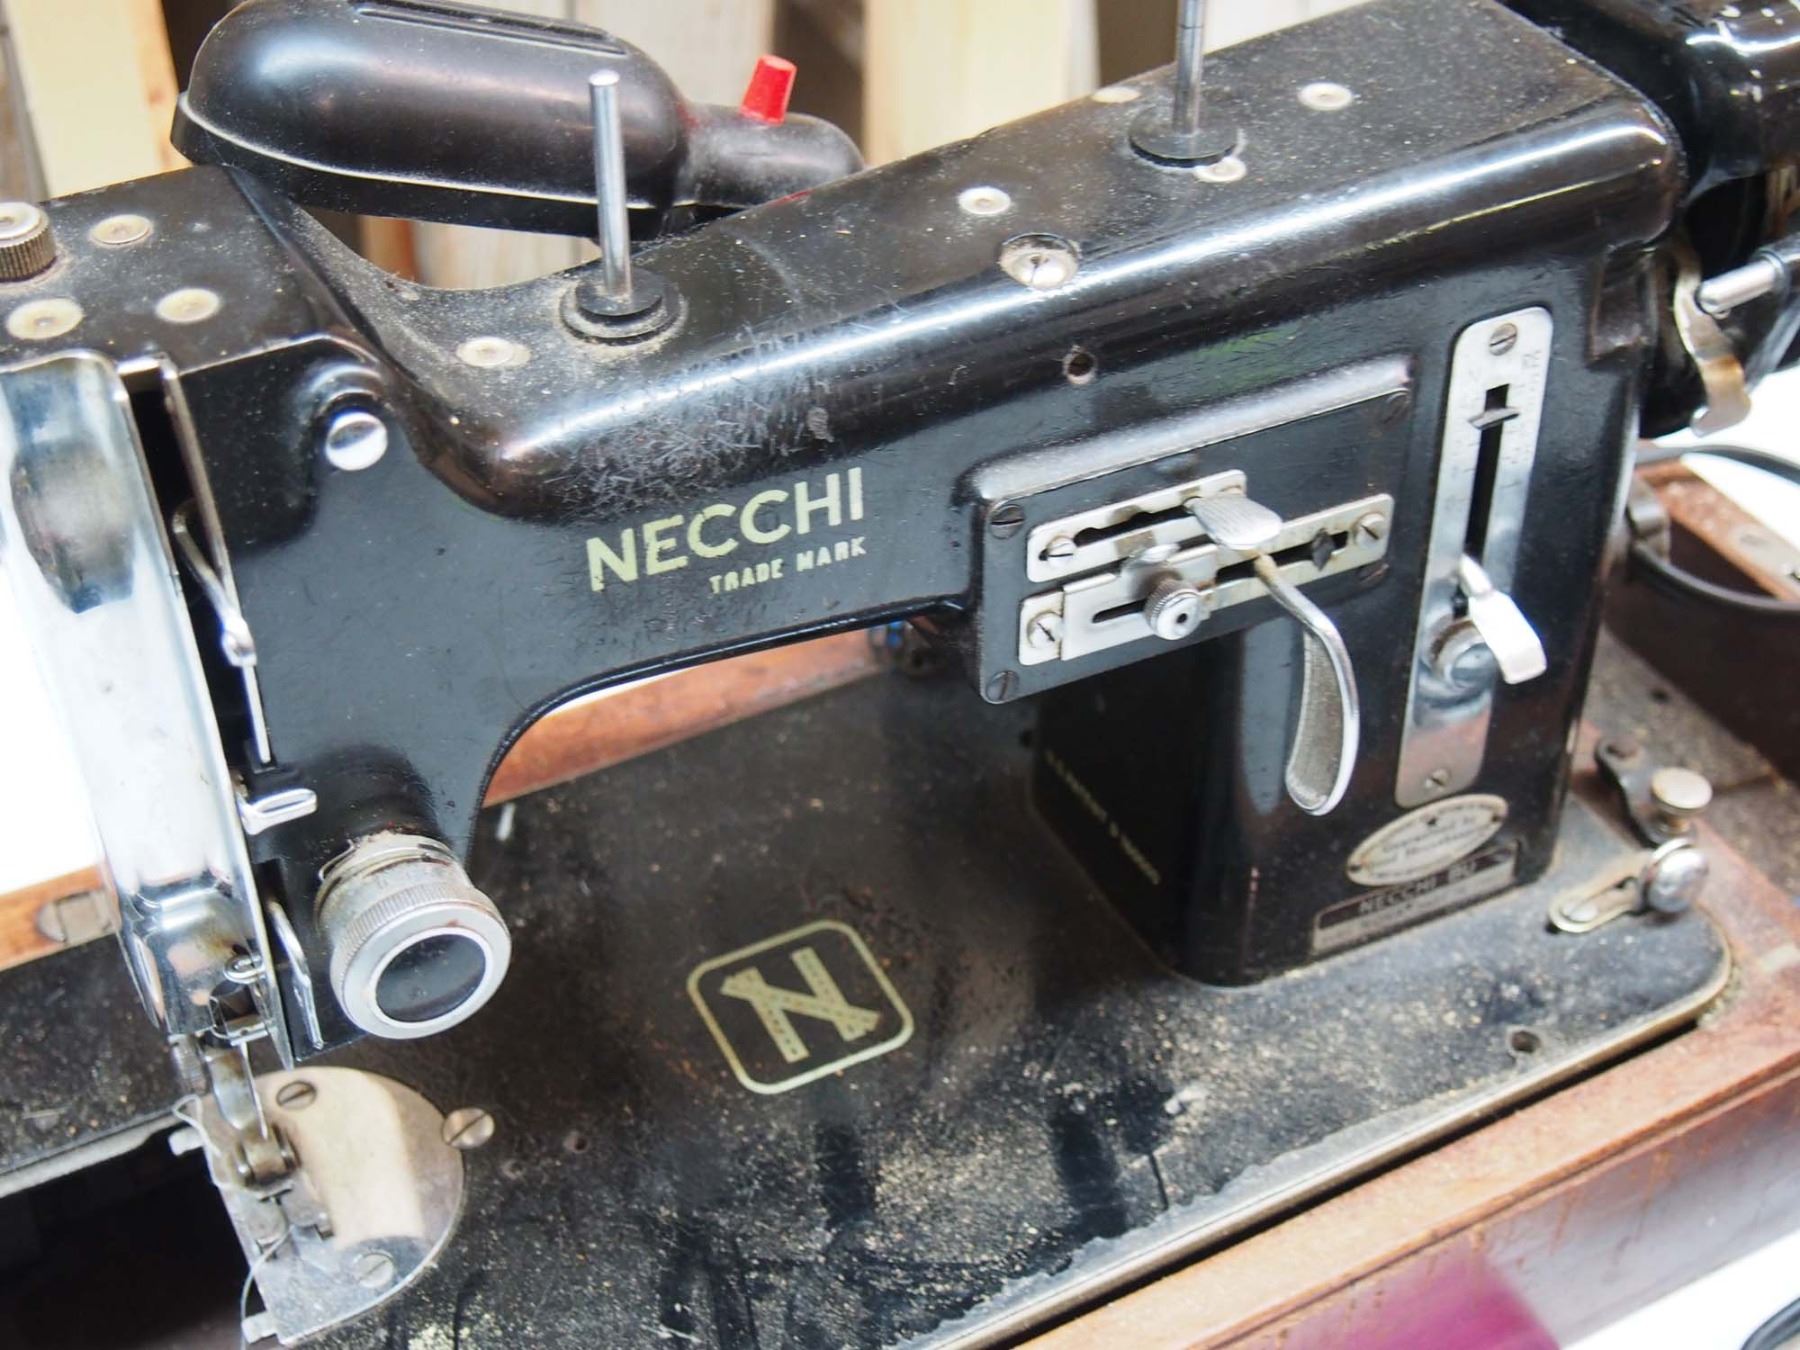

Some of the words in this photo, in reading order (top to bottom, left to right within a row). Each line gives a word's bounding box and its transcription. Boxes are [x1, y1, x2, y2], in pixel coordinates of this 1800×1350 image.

[586, 467, 864, 592] NECCHI
[709, 559, 783, 594] TRADE
[796, 536, 867, 572] MARK
[720, 946, 880, 1063] N
